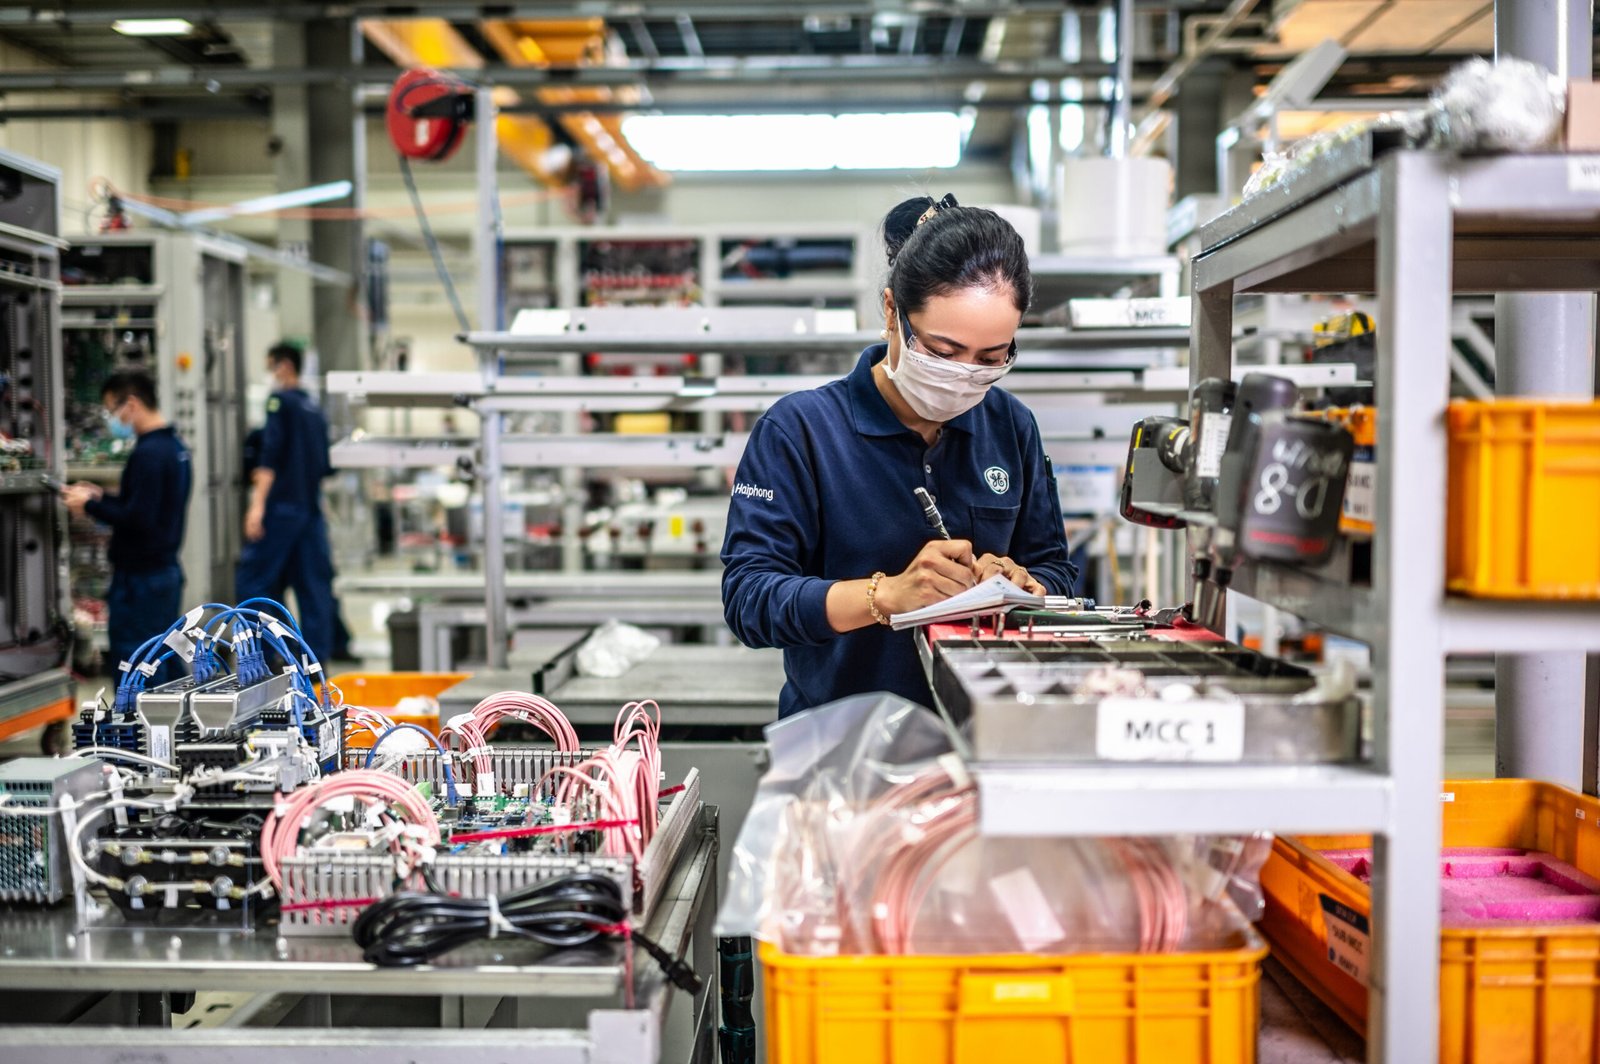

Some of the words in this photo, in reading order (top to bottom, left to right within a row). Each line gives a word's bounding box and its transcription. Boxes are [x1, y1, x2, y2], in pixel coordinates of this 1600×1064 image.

[735, 483, 774, 501] Haiphong
[1126, 719, 1191, 743] MCC
[1206, 721, 1215, 744] 1
